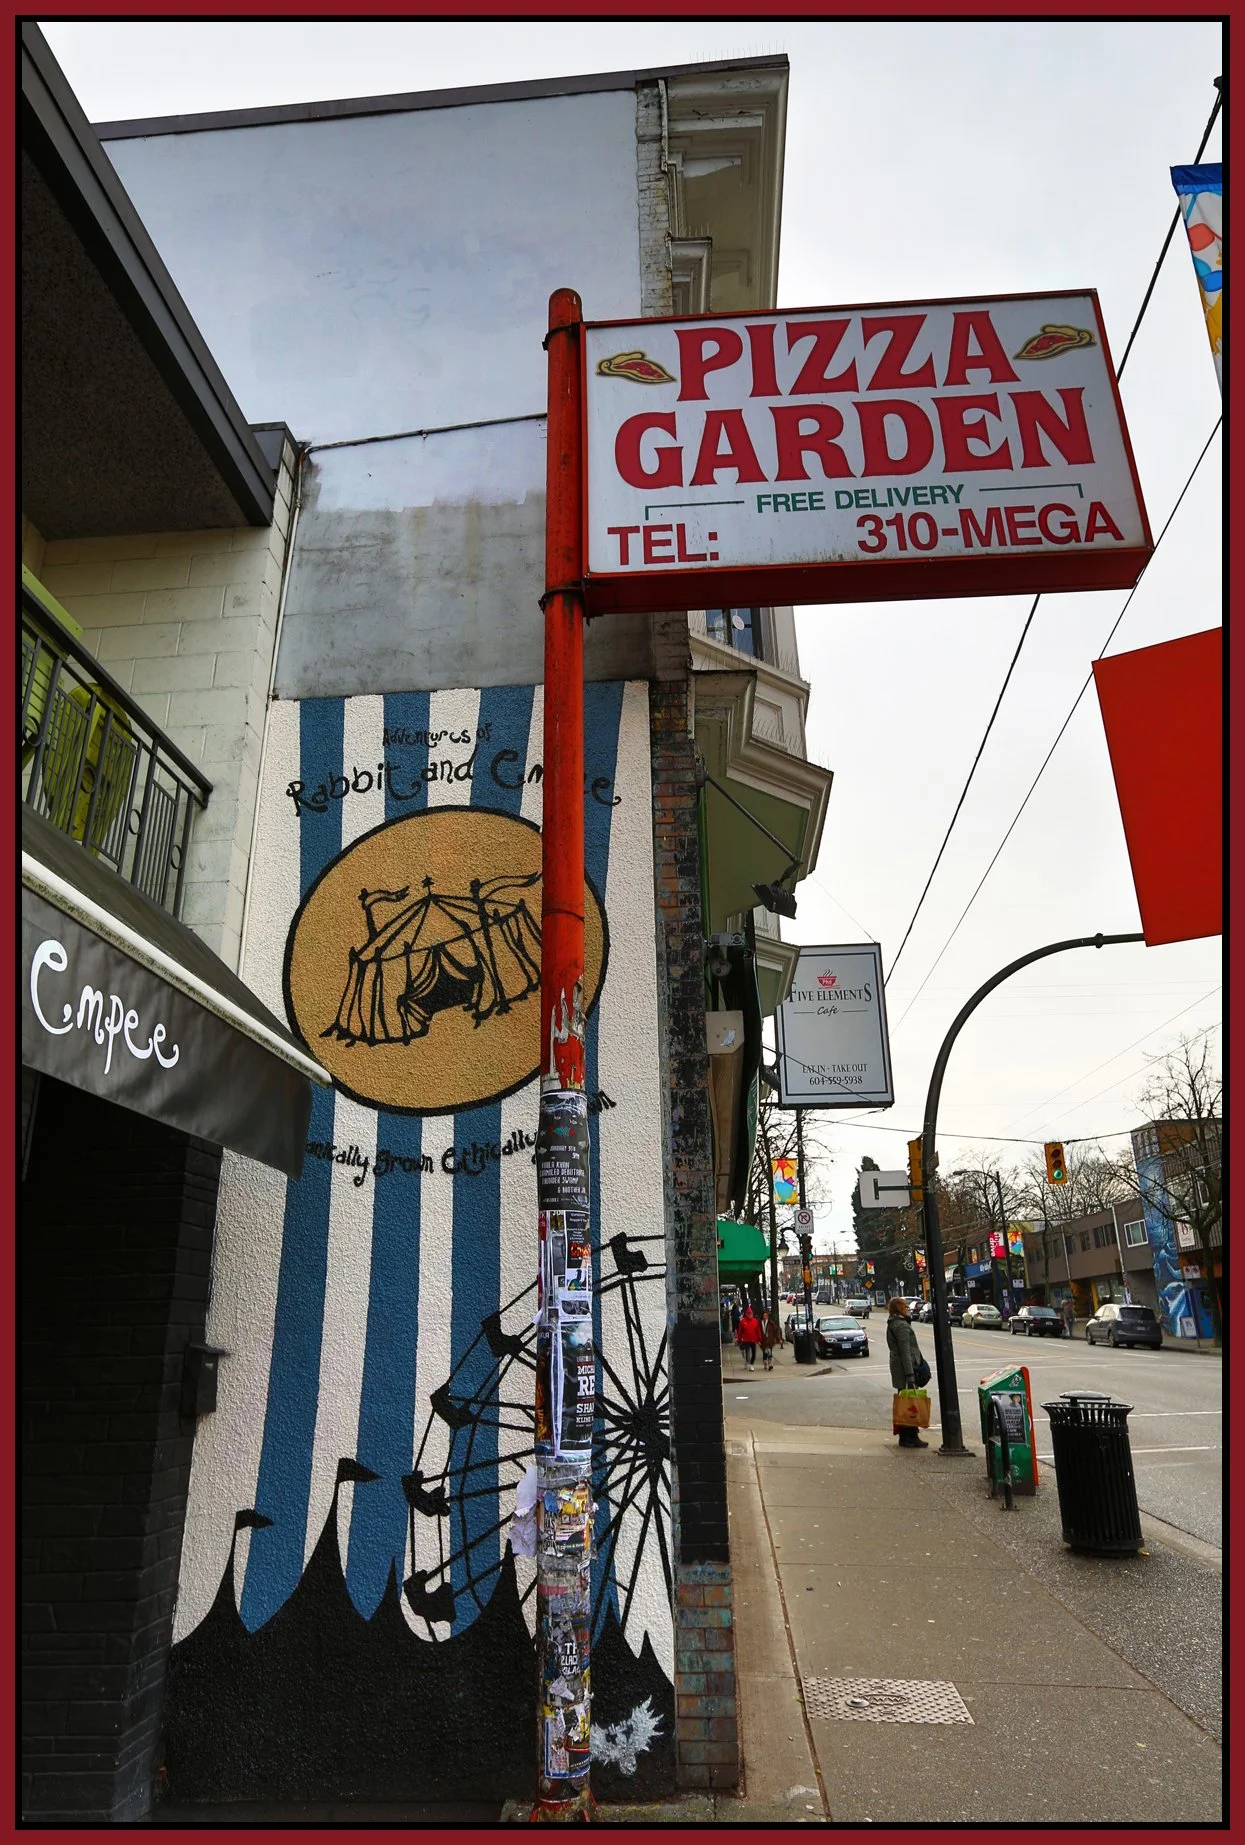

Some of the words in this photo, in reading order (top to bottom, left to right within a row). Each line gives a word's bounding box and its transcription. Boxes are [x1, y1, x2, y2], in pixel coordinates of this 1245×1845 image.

[673, 310, 1020, 402] PIZZA
[614, 387, 1095, 490] GARDEN
[756, 490, 826, 514] FREE
[834, 484, 965, 510] DELIVERY
[607, 524, 720, 566] TEL:
[855, 501, 1125, 554] 310-MEGA
[286, 760, 422, 817] Rabbit
[420, 743, 479, 785] and
[789, 982, 814, 1003] FIVE
[802, 1064, 816, 1074] EAT
[817, 1064, 826, 1073] IN
[832, 1064, 851, 1073] TAKE
[851, 1063, 868, 1072] OUT
[809, 1075, 863, 1086] 604-559-5938
